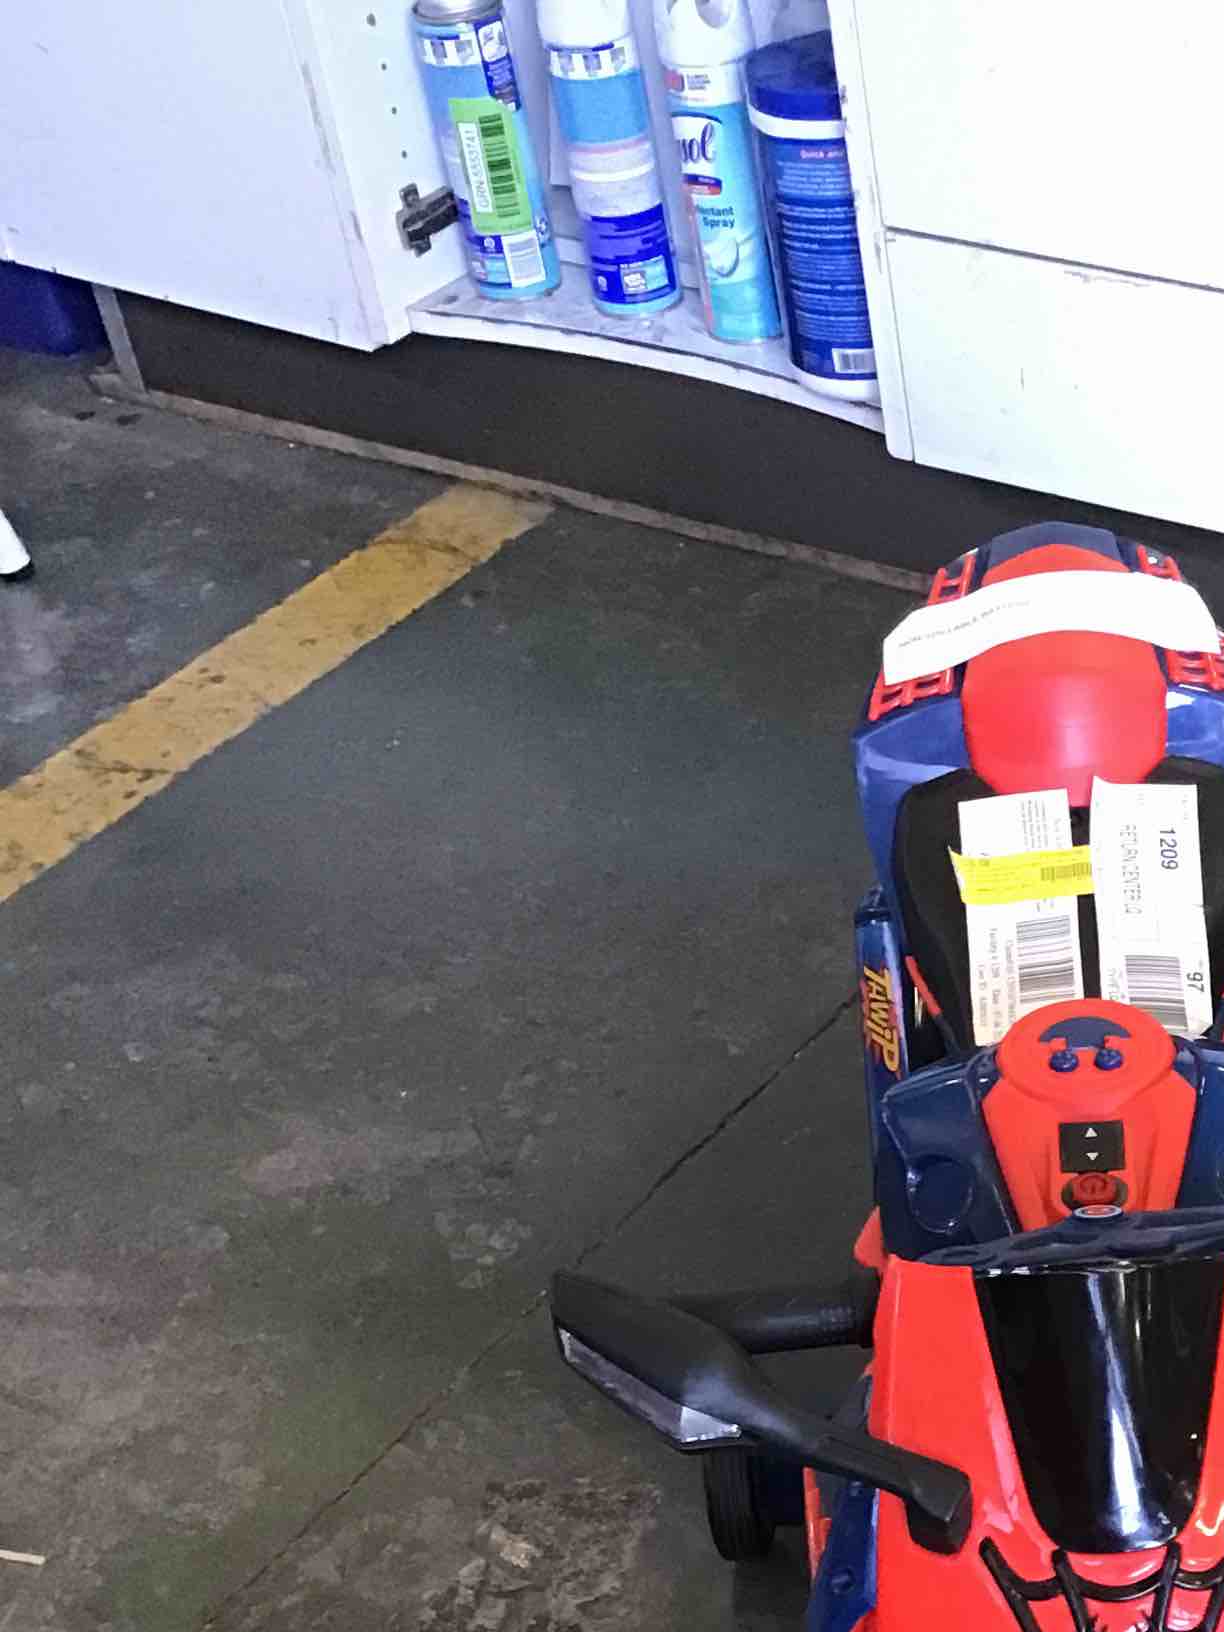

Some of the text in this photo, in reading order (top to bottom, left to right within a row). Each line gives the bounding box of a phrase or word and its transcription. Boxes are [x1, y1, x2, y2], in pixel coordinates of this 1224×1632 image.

[702, 216, 735, 230] Spray
[1159, 827, 1179, 870] 1209
[1186, 971, 1205, 993] 97
